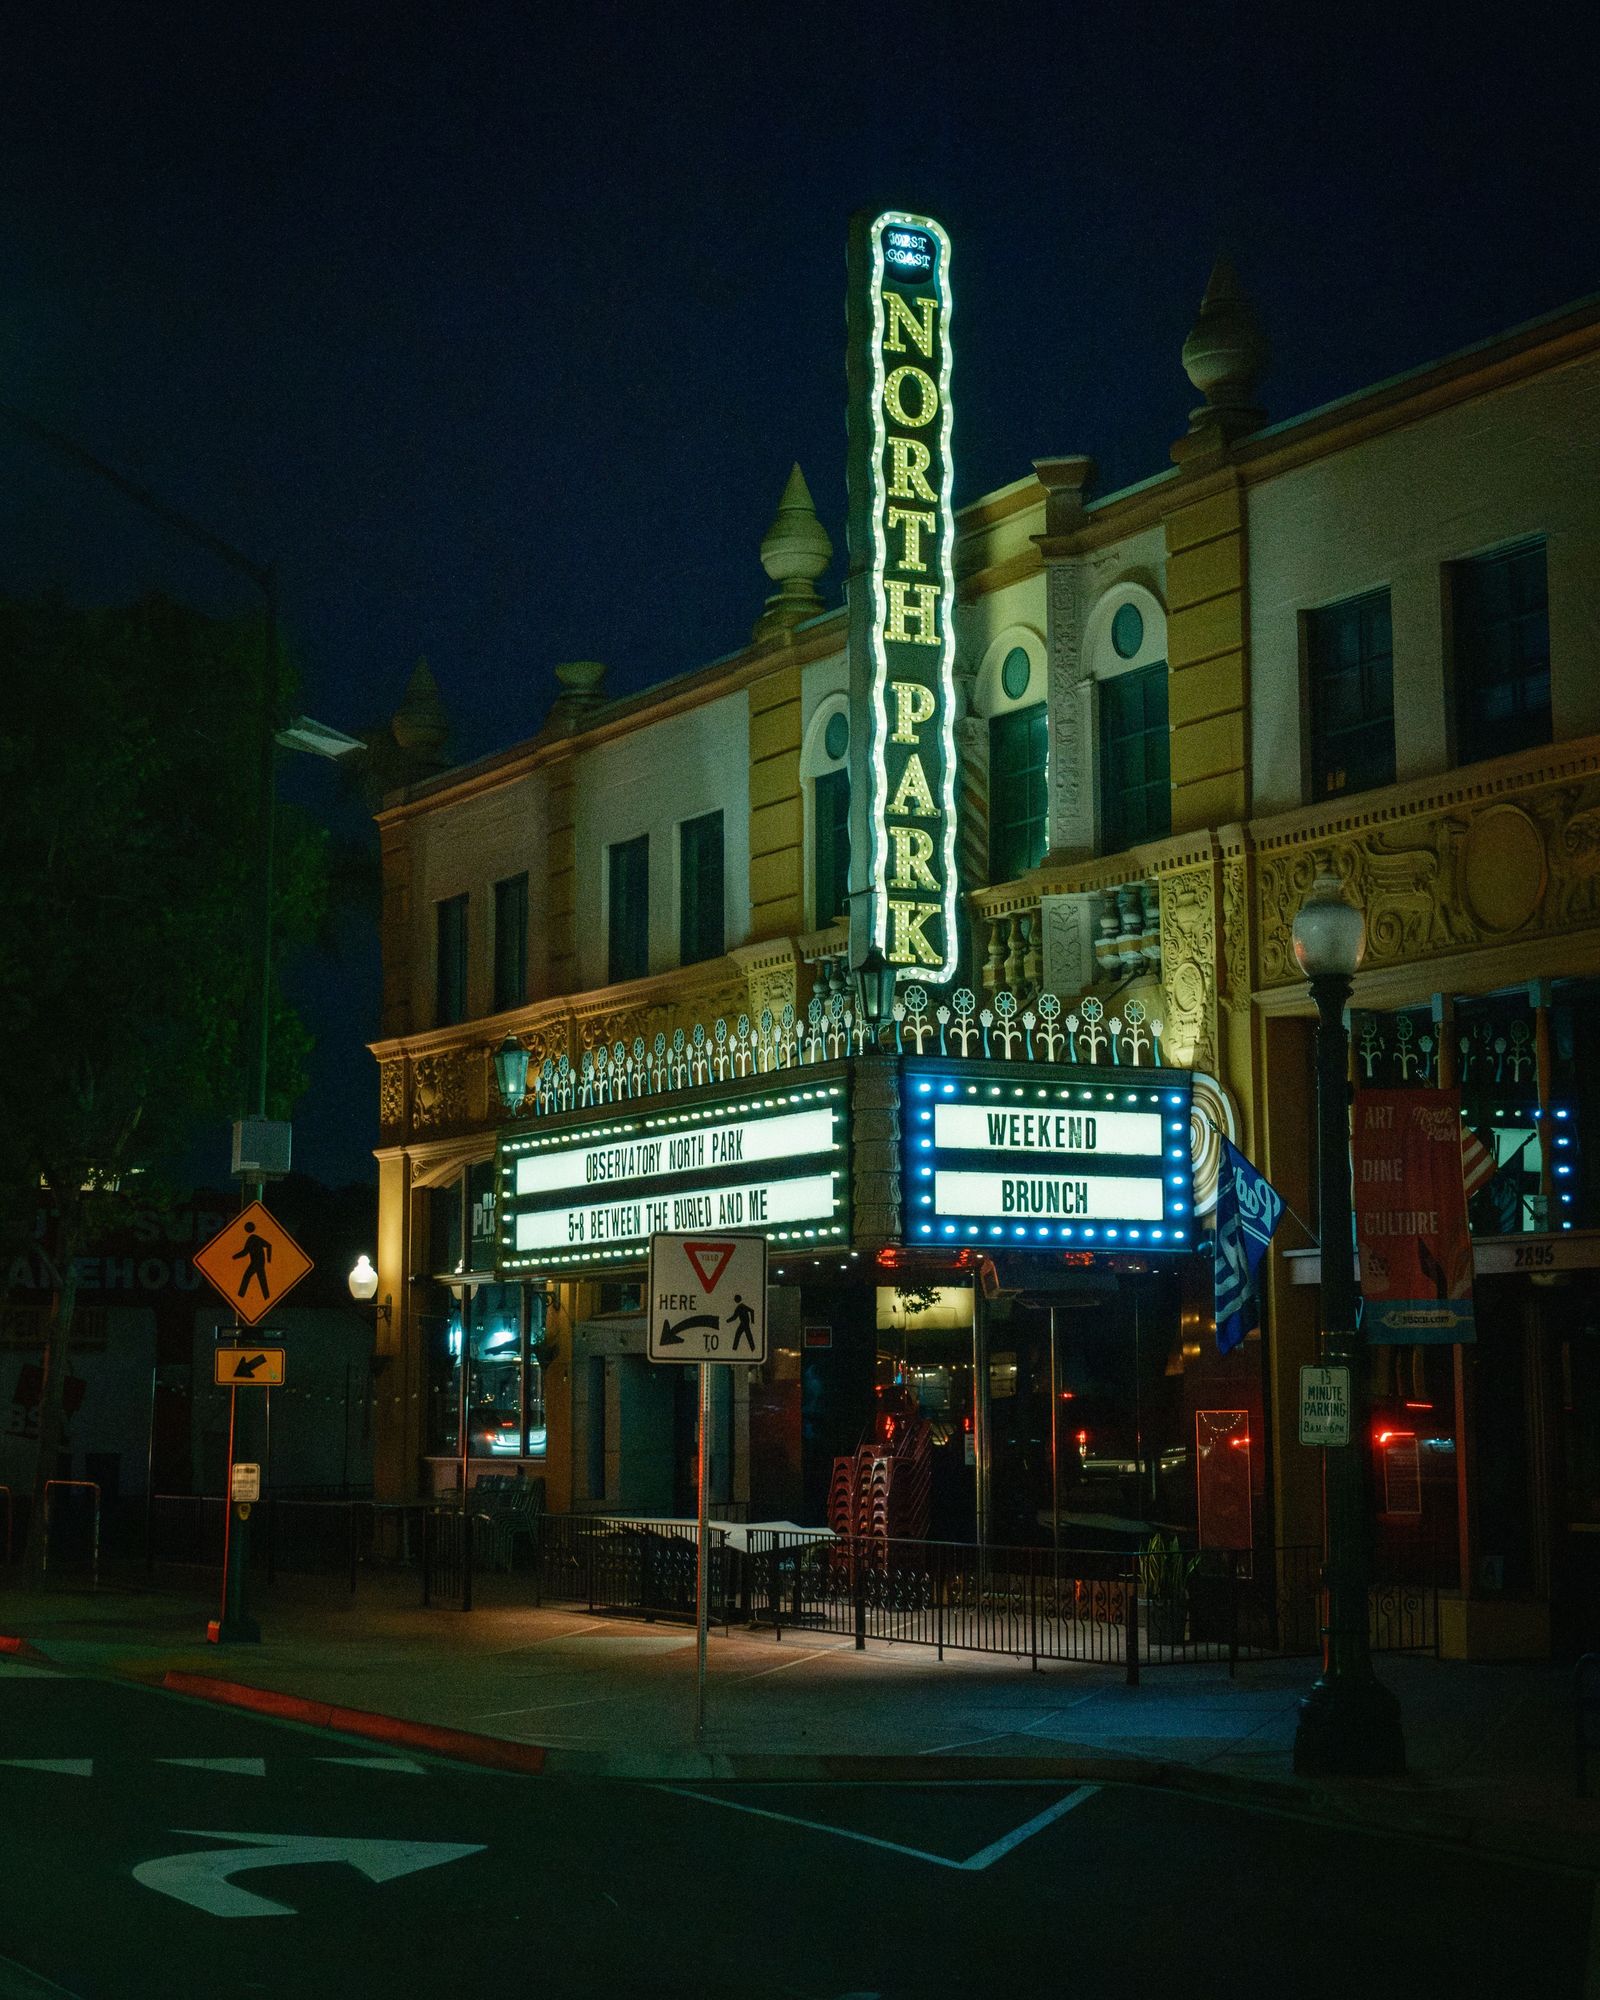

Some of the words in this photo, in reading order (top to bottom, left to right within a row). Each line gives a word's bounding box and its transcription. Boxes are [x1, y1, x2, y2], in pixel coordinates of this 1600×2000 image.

[888, 231, 927, 251] WEST
[887, 249, 930, 267] COAST
[882, 292, 942, 645] NORTH
[887, 682, 943, 965] PARK
[1364, 1105, 1394, 1129] ART
[986, 1112, 1097, 1150] WEEKEND
[586, 1142, 662, 1183] OBSERVATORY
[669, 1135, 704, 1170] NORTH
[712, 1129, 744, 1164] PARK
[1362, 1158, 1404, 1182] DINE
[1001, 1179, 1088, 1214] BRUNCH
[568, 1212, 585, 1242] 5-8
[590, 1204, 641, 1239] BETWEEN
[646, 1202, 669, 1232] THE
[674, 1196, 712, 1229] BURIED
[719, 1192, 744, 1226] AND
[749, 1189, 768, 1221] ME
[1364, 1211, 1439, 1236] CULTURE
[659, 1294, 697, 1311] HERE
[703, 1334, 719, 1350] TO
[1320, 1370, 1331, 1385] 15
[1308, 1386, 1342, 1401] MINUTE
[1304, 1402, 1346, 1417] PARKING
